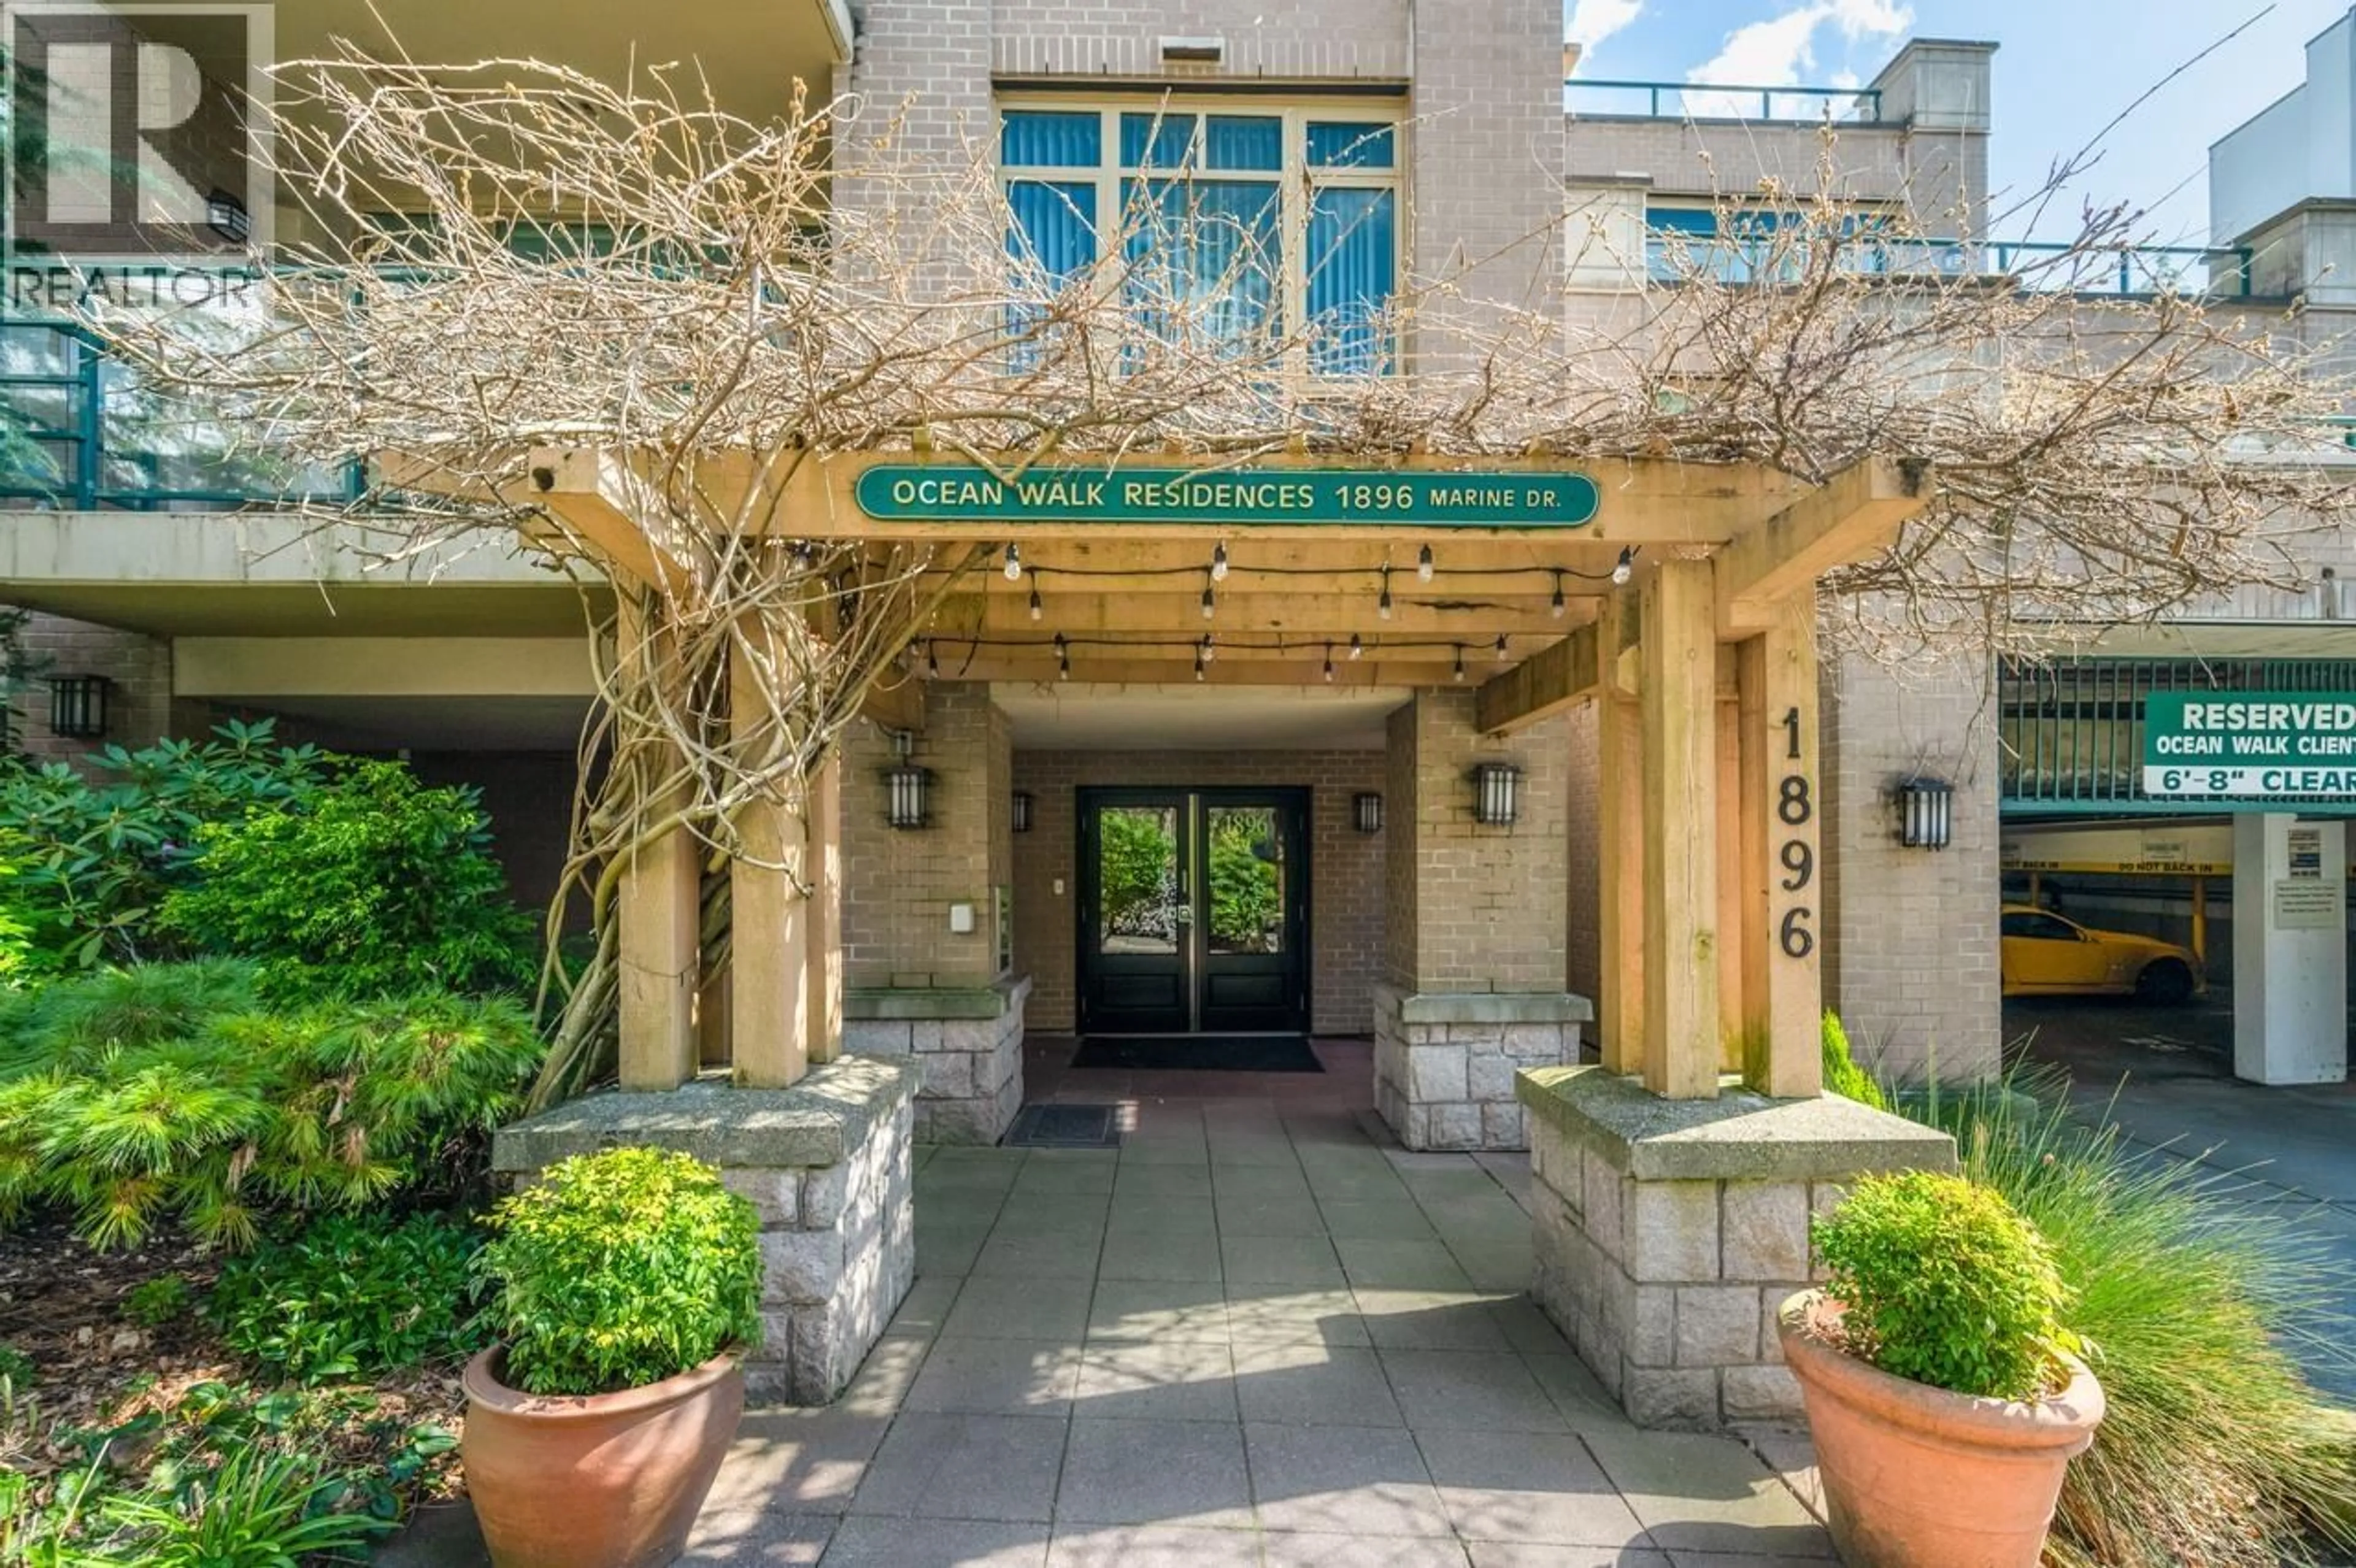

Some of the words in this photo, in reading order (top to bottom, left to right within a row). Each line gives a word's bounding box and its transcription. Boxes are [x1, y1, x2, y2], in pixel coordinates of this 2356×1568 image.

[892, 479, 1003, 505] OCEAN
[1018, 481, 1104, 505] WALK
[1124, 483, 1314, 508] RESIDENCES
[1334, 485, 1414, 509] 1896
[1429, 489, 1515, 507] MARINE
[1526, 490, 1562, 508] DR.
[2183, 704, 2356, 729] RESERVED
[2156, 736, 2223, 754] OCEAN
[2232, 736, 2290, 754] WALK
[1225, 815, 1268, 836] 1896
[1778, 707, 1813, 958] 1896
[2136, 861, 2160, 871] NOT
[2164, 862, 2195, 872] BACK
